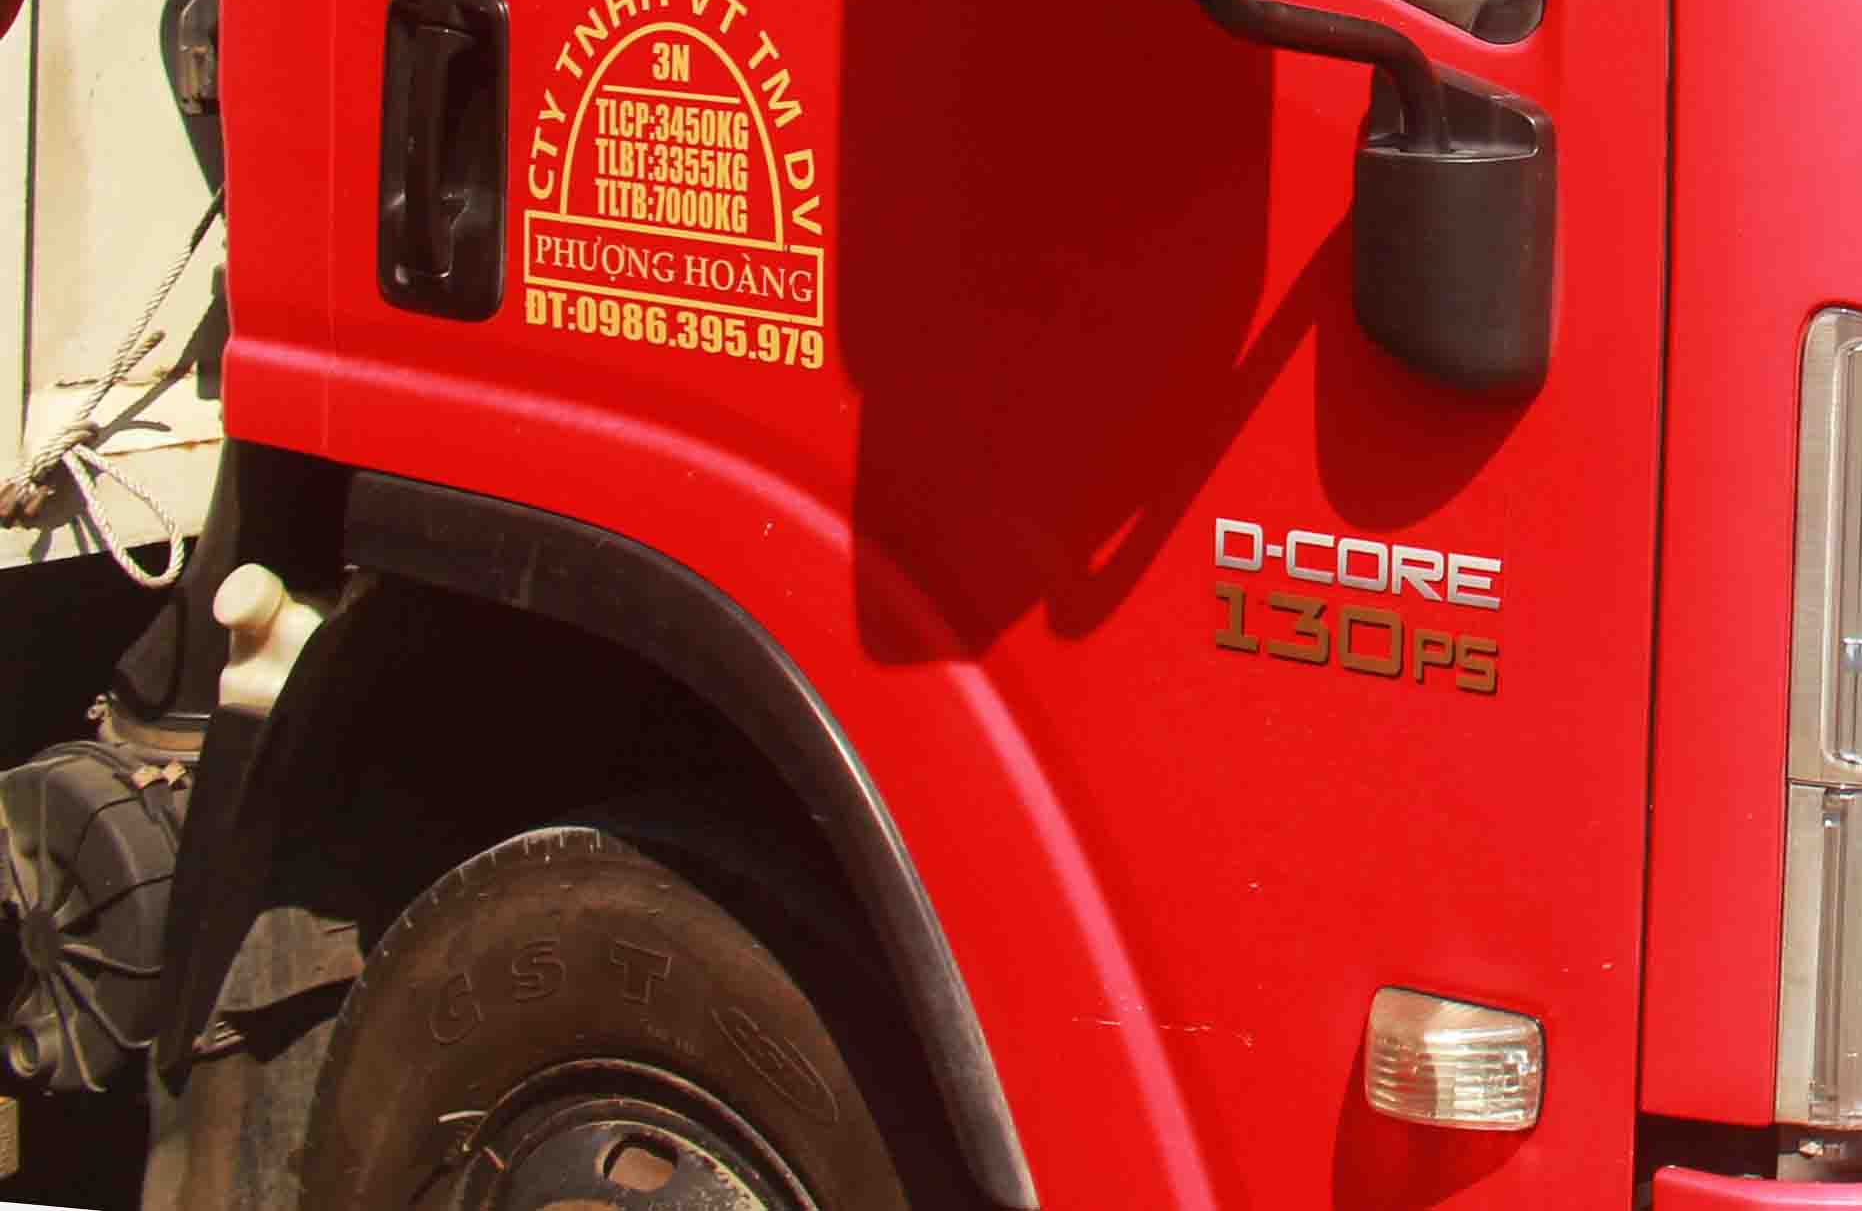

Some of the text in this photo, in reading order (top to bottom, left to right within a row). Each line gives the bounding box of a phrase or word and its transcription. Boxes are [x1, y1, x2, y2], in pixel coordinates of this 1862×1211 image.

[651, 42, 691, 82] 3N
[527, 89, 568, 201] CTY
[747, 30, 804, 129] TM
[784, 149, 823, 235] DV
[595, 98, 750, 151] TLCP:3450KG
[595, 139, 749, 191] TLBT:3355KG
[595, 178, 748, 234] TLTB:7000KG
[534, 234, 814, 303] PHƯỢNG HOÀNG
[524, 288, 825, 370] ĐT:0986.395.979
[1214, 517, 1502, 611] D-CORE
